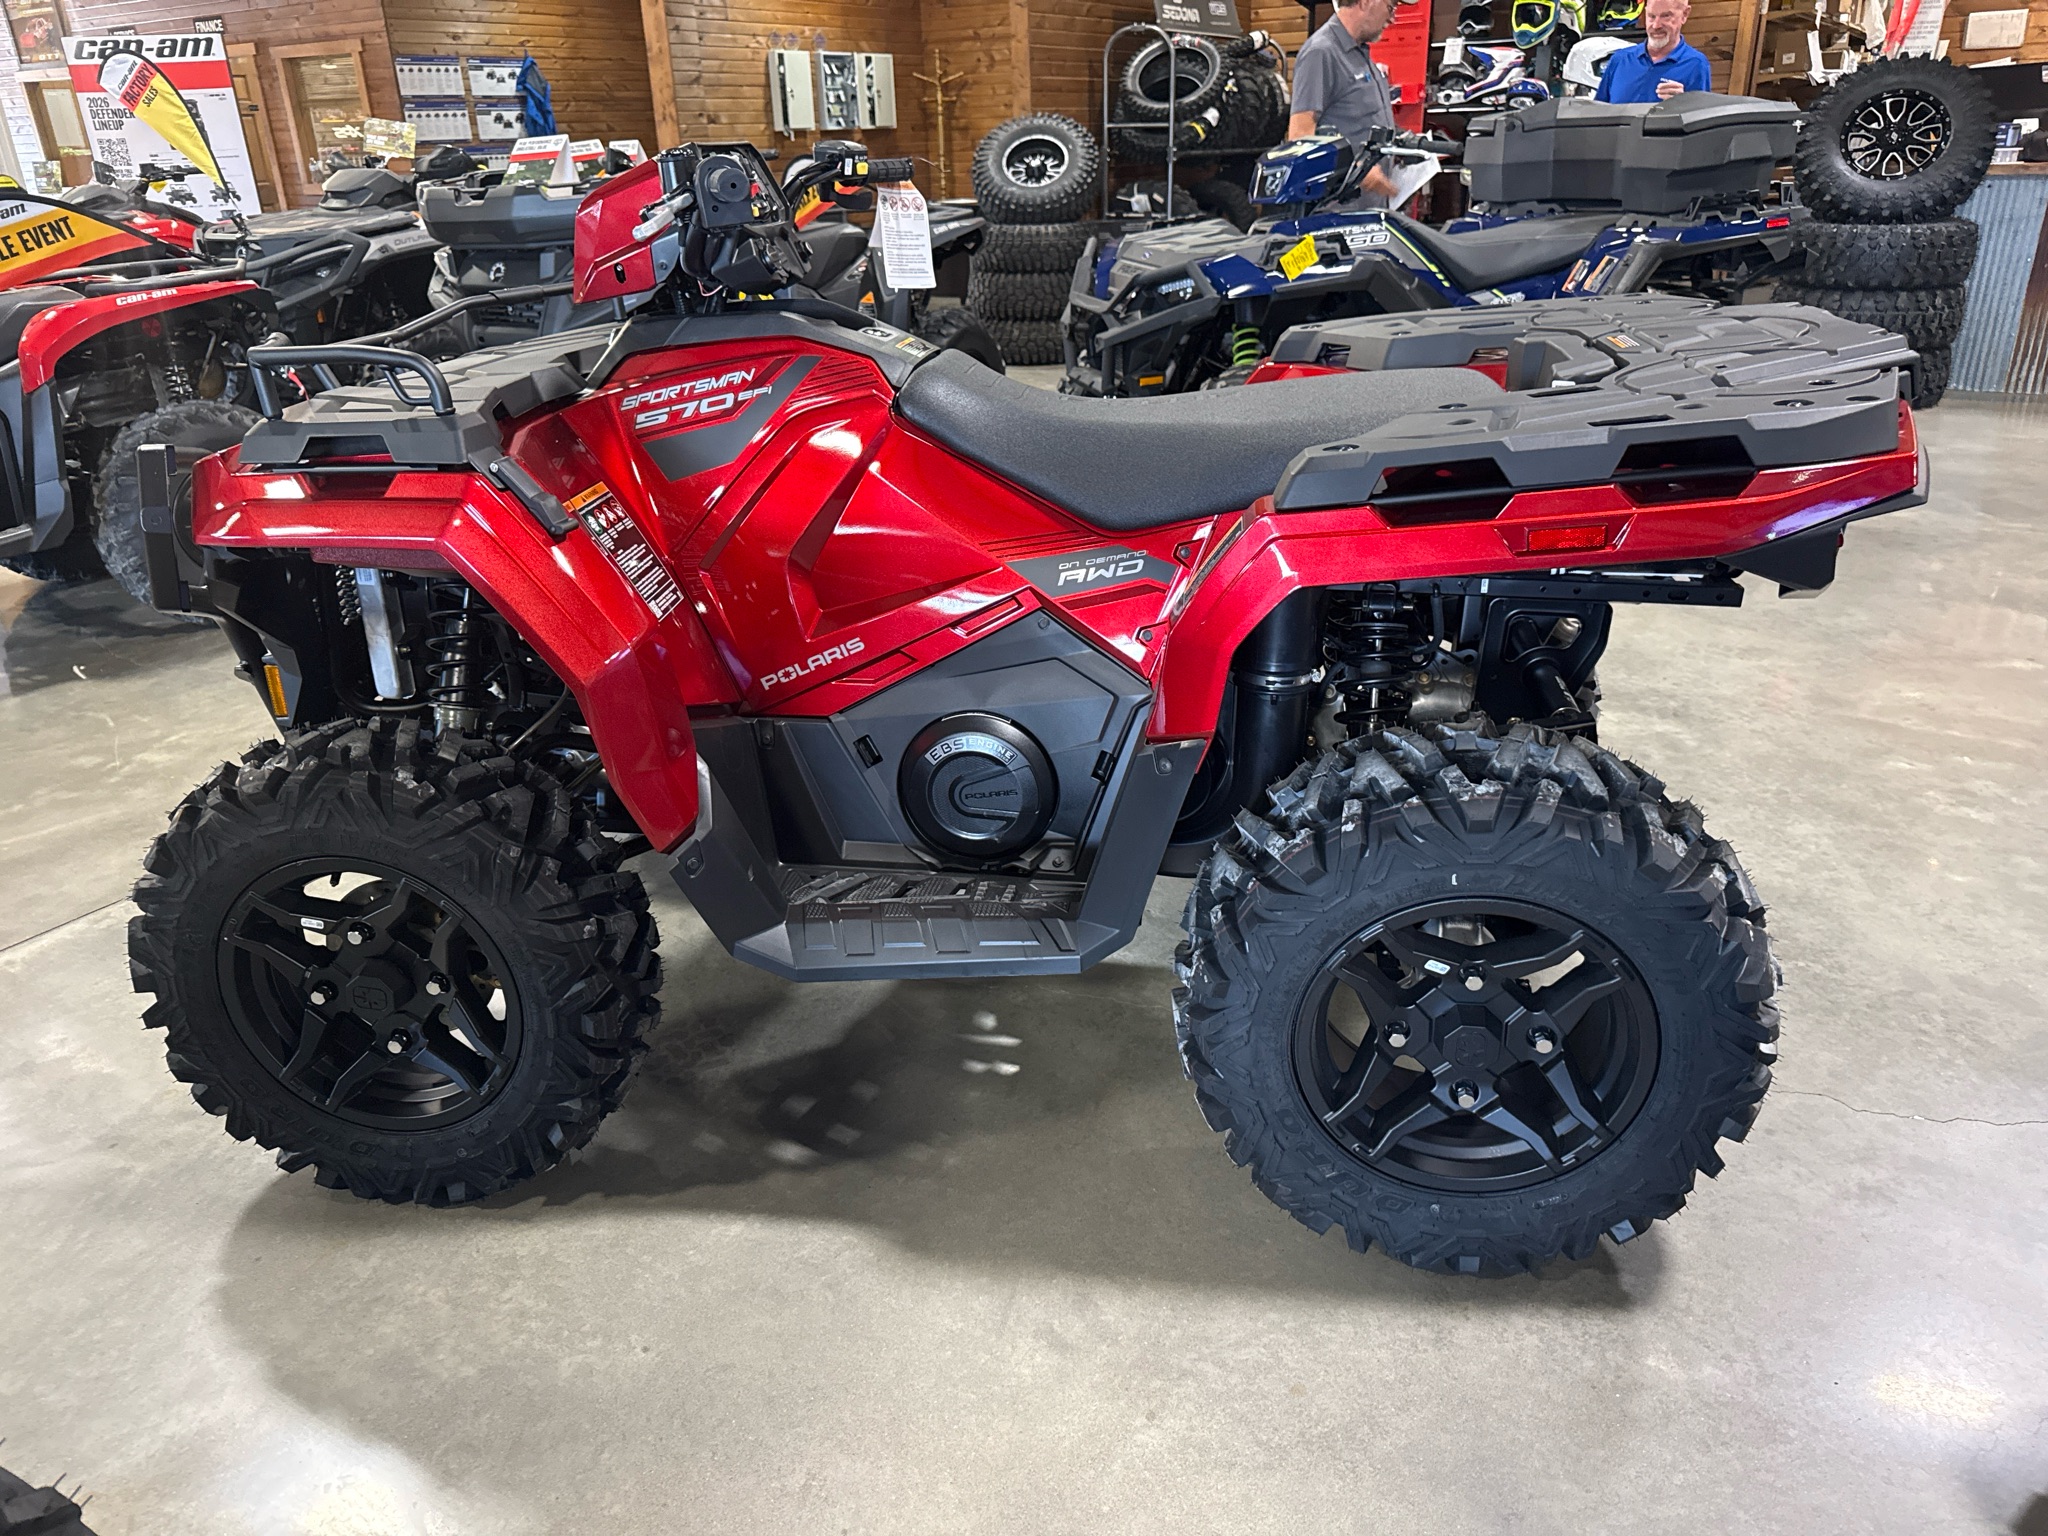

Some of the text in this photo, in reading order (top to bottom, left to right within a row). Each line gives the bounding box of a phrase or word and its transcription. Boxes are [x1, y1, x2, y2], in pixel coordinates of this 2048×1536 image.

[195, 19, 224, 33] FINANCE
[74, 36, 214, 60] can-am
[117, 60, 138, 91] can-am
[122, 63, 155, 108] FACTORY
[86, 97, 110, 108] 2026
[141, 86, 159, 108] SALES
[92, 119, 125, 131] LINEUP
[16, 215, 76, 252] EVENT
[1345, 232, 1391, 249] 50
[116, 287, 178, 306] can-am
[620, 367, 756, 411] SPORTSMAN
[634, 385, 773, 430] 570 EFI
[1058, 550, 1147, 570] ON DEMAND
[1057, 558, 1145, 587] AWD
[760, 637, 865, 691] POLARIS
[929, 738, 965, 762] EBS
[968, 737, 1014, 760] ENGINE
[964, 789, 1019, 800] POLARIS
